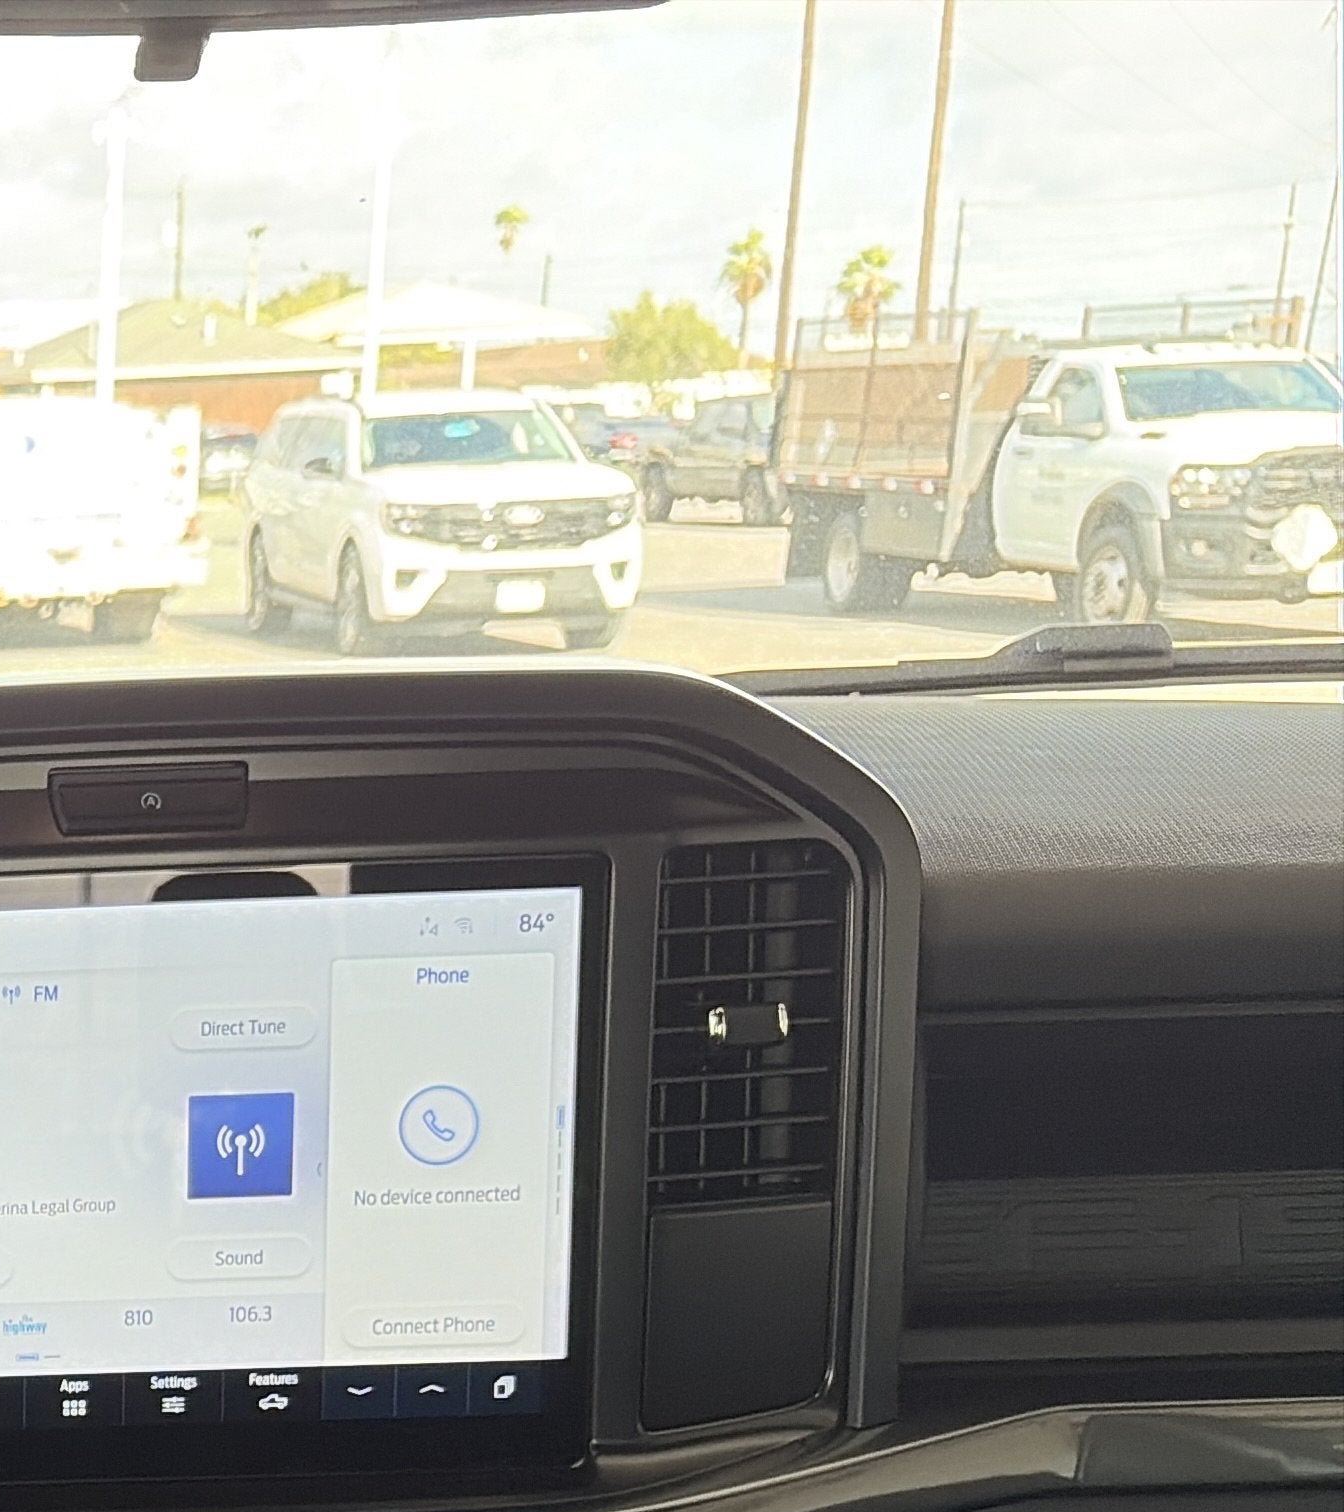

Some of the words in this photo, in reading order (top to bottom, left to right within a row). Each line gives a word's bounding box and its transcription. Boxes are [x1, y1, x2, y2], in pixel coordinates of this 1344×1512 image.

[518, 913, 555, 933] 84°
[416, 968, 470, 984] Phone
[33, 985, 59, 1002] FM
[200, 1020, 244, 1037] Direct
[249, 1018, 286, 1035] Tune
[354, 1190, 377, 1206] No
[380, 1188, 432, 1205] device
[435, 1184, 521, 1203] connected
[32, 1198, 70, 1217] Legal
[72, 1197, 116, 1214] Group
[214, 1249, 264, 1267] Sound
[124, 1309, 153, 1327] 810
[229, 1305, 273, 1323] 106.3
[372, 1317, 439, 1335] Connect
[443, 1316, 495, 1333] Phone
[60, 1378, 90, 1394] Apps
[150, 1375, 198, 1391] Settings
[248, 1372, 299, 1387] Features
